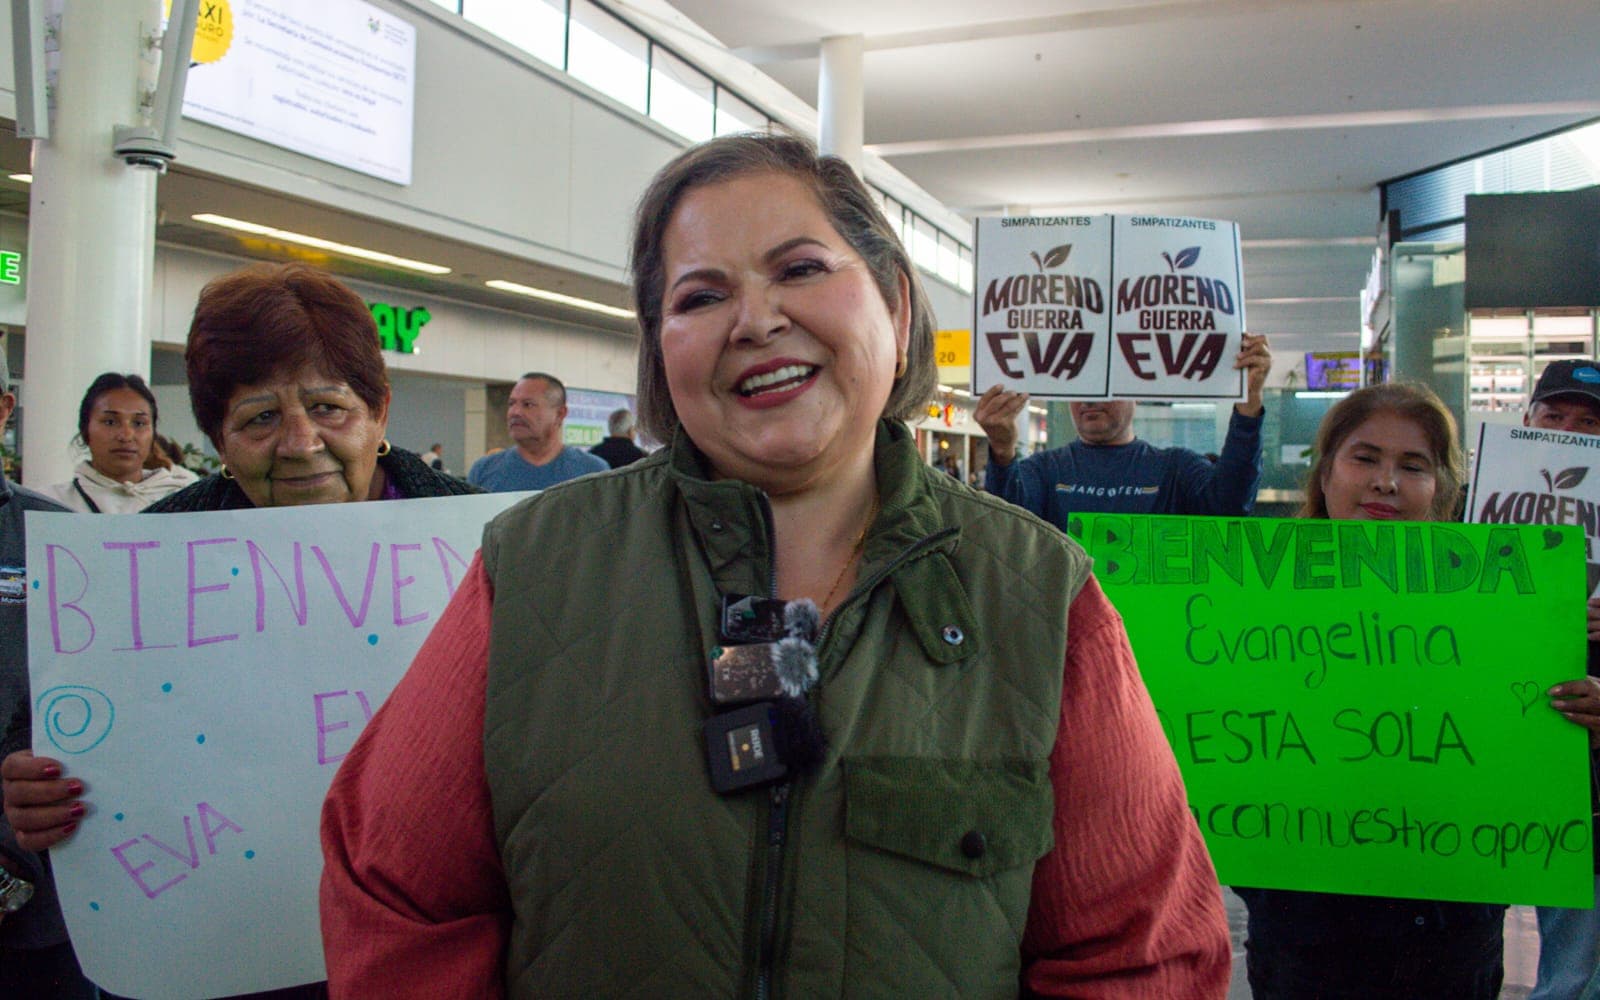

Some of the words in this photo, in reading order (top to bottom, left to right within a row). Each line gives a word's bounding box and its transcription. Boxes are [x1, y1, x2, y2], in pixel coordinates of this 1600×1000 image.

[198, 1, 222, 24] XI
[1001, 216, 1091, 228] SIMPATIZANTES
[1130, 216, 1216, 231] SIMPATIZANTES
[983, 274, 1105, 316] MORENO
[1116, 274, 1235, 316] MORENO
[1007, 309, 1084, 330] GUERRA
[1139, 309, 1216, 331] GUERRA
[938, 351, 956, 364] 20
[985, 332, 1095, 381] EVA
[1116, 332, 1228, 382] EVA
[1480, 491, 1600, 538] MOREN
[1091, 516, 1536, 595] BIENVENIDA
[1185, 593, 1461, 690] Evangelina
[1186, 709, 1317, 766] ESTA
[1332, 708, 1475, 767] SOLA
[111, 802, 243, 899] EVA
[1472, 819, 1589, 871] apoyo
